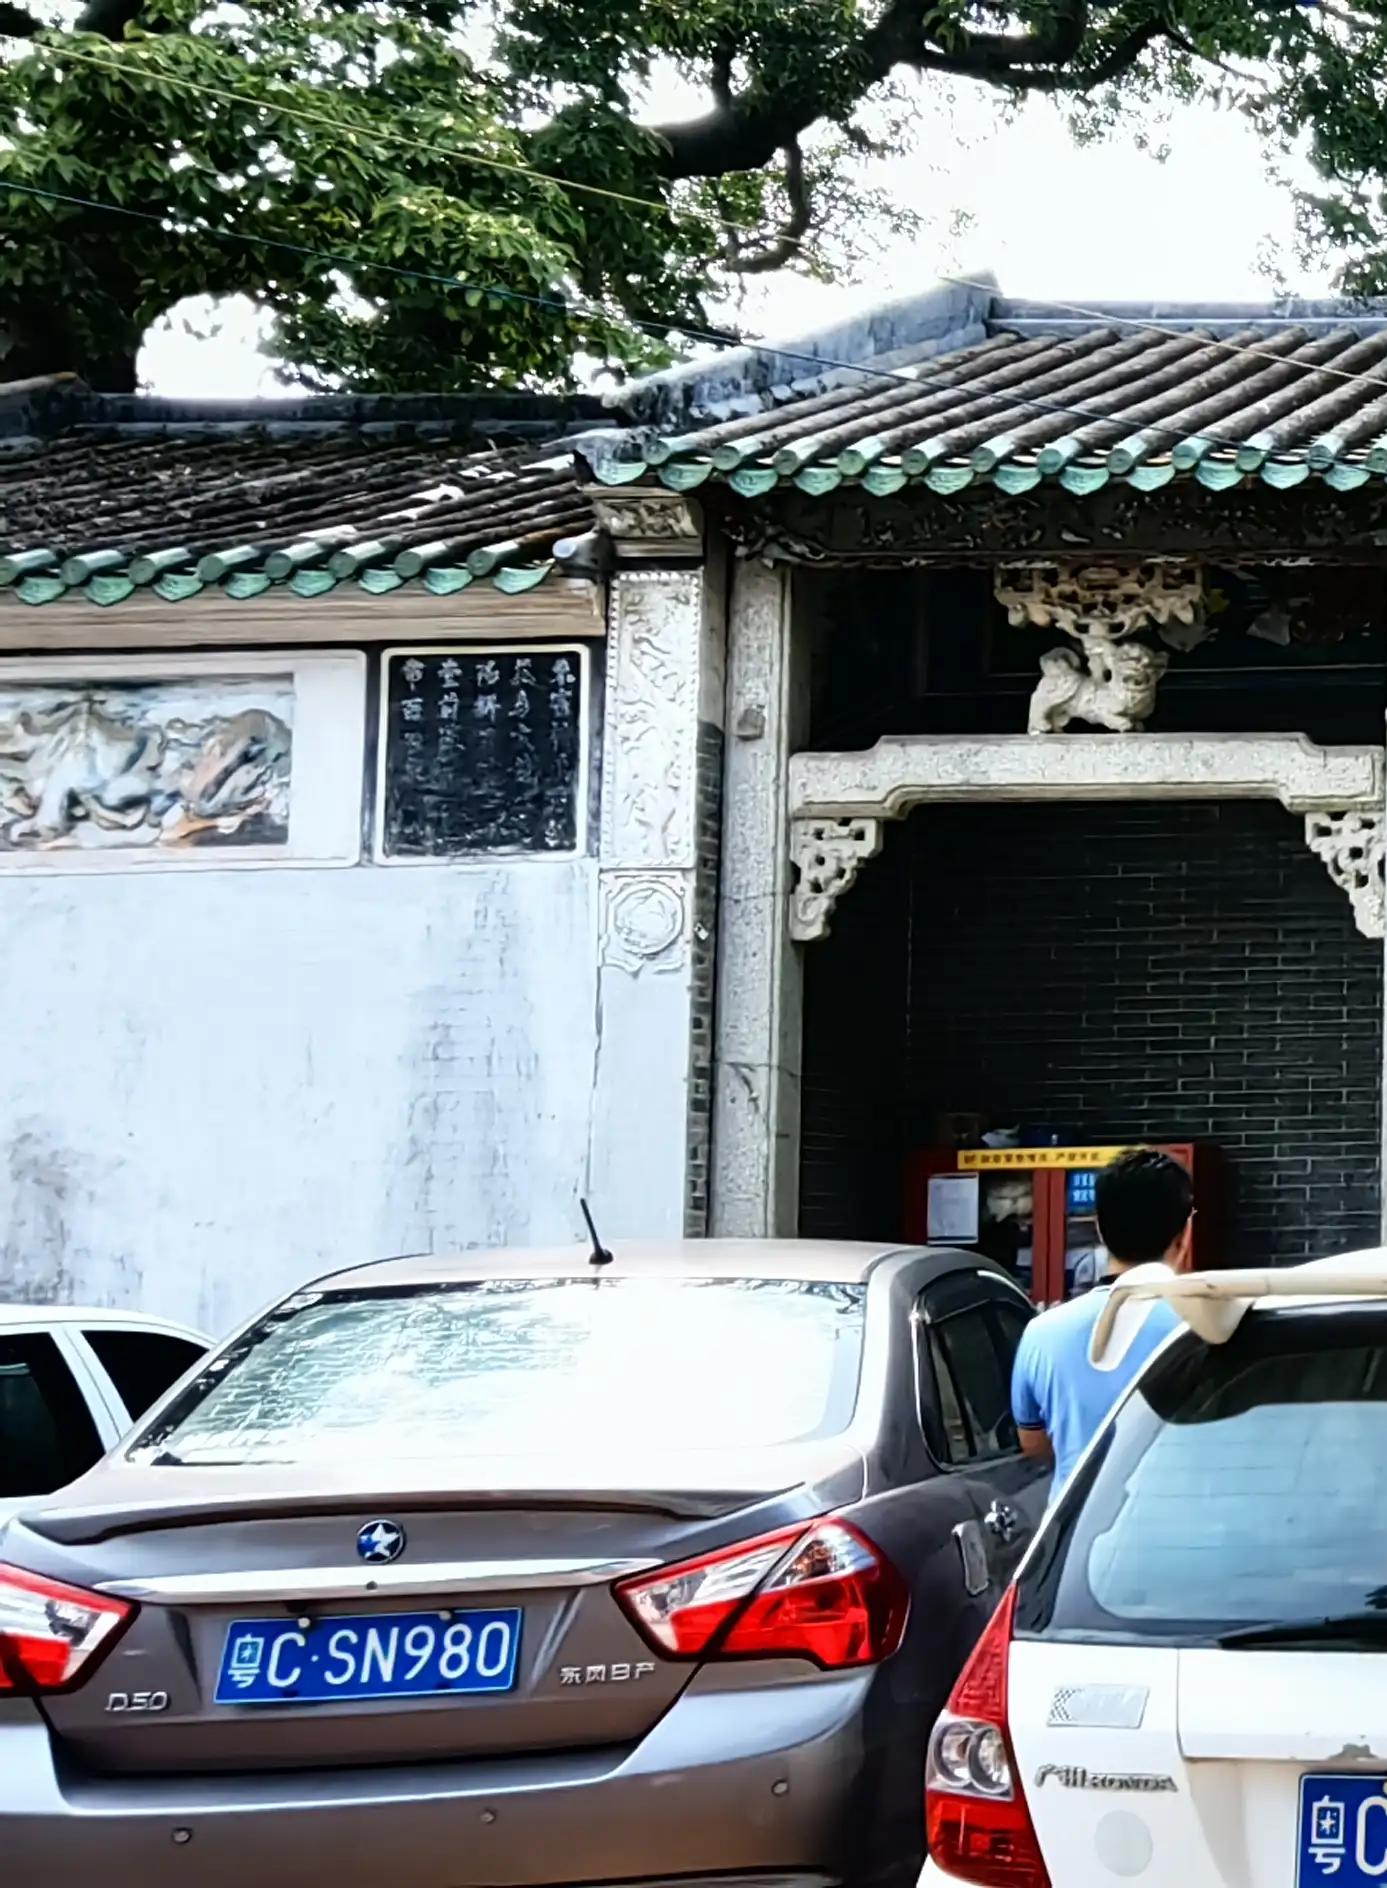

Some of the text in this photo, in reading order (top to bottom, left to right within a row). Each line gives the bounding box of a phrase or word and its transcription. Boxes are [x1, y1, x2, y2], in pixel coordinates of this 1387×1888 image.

[560, 1661, 656, 1684] 东风日产
[104, 1691, 168, 1711] D50
